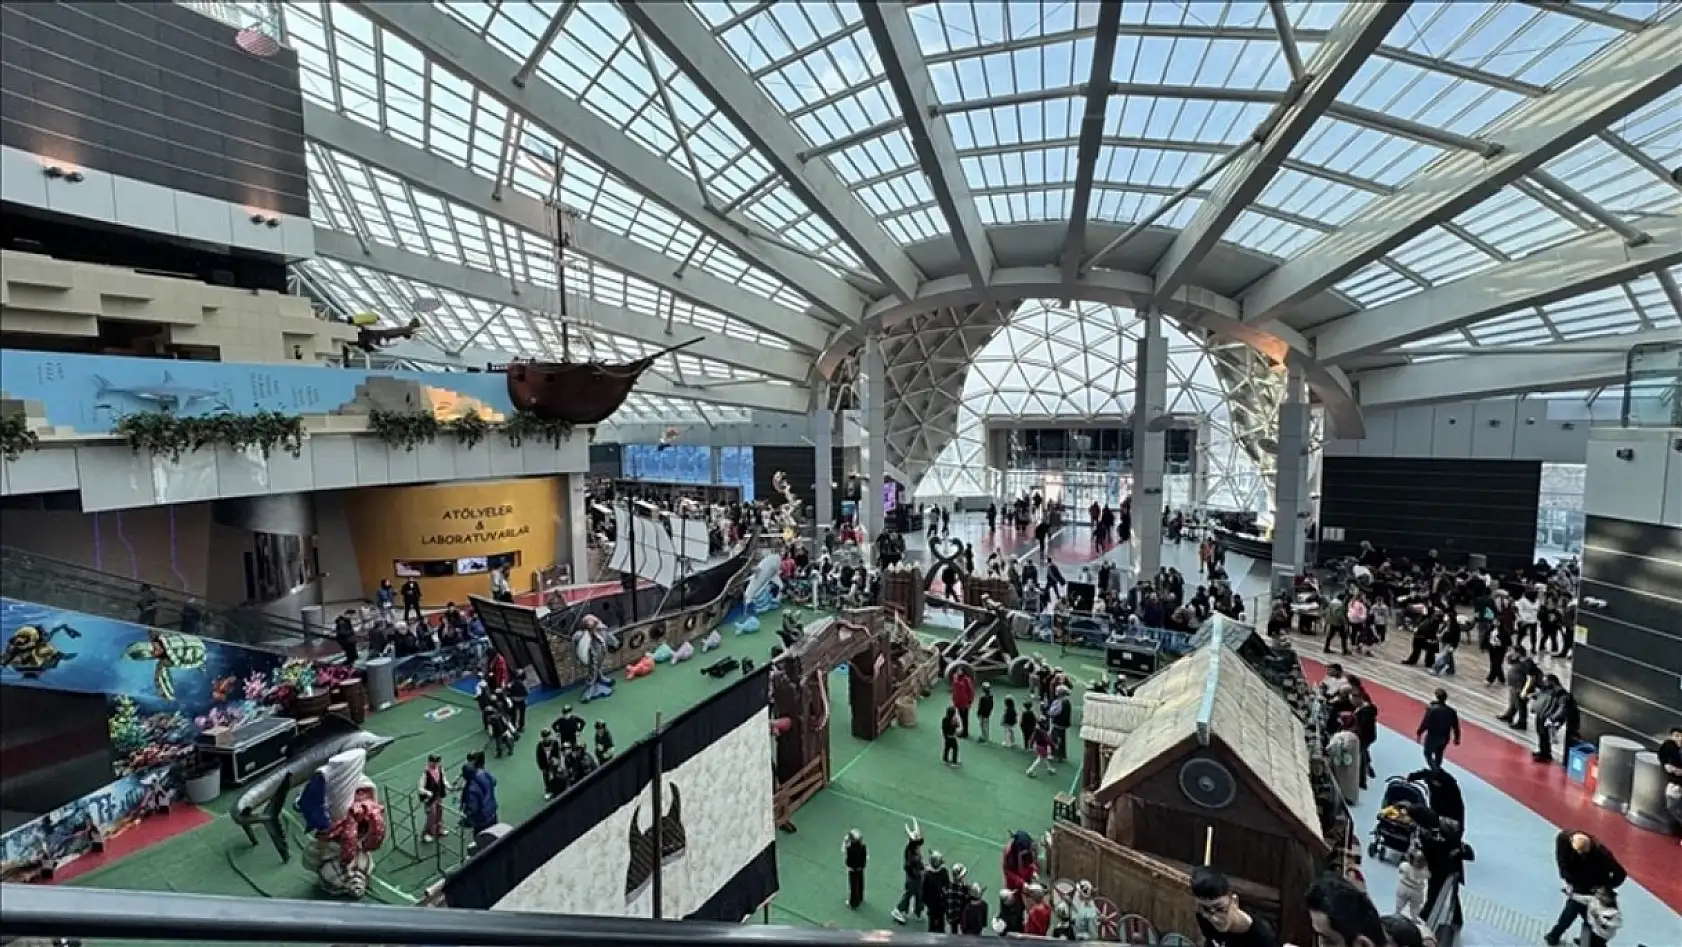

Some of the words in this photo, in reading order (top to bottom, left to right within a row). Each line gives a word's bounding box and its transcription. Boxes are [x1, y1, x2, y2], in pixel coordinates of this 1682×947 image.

[442, 505, 513, 520] ATÖLYELER
[475, 521, 484, 530] &
[421, 525, 529, 544] LABORATUVARLAR
